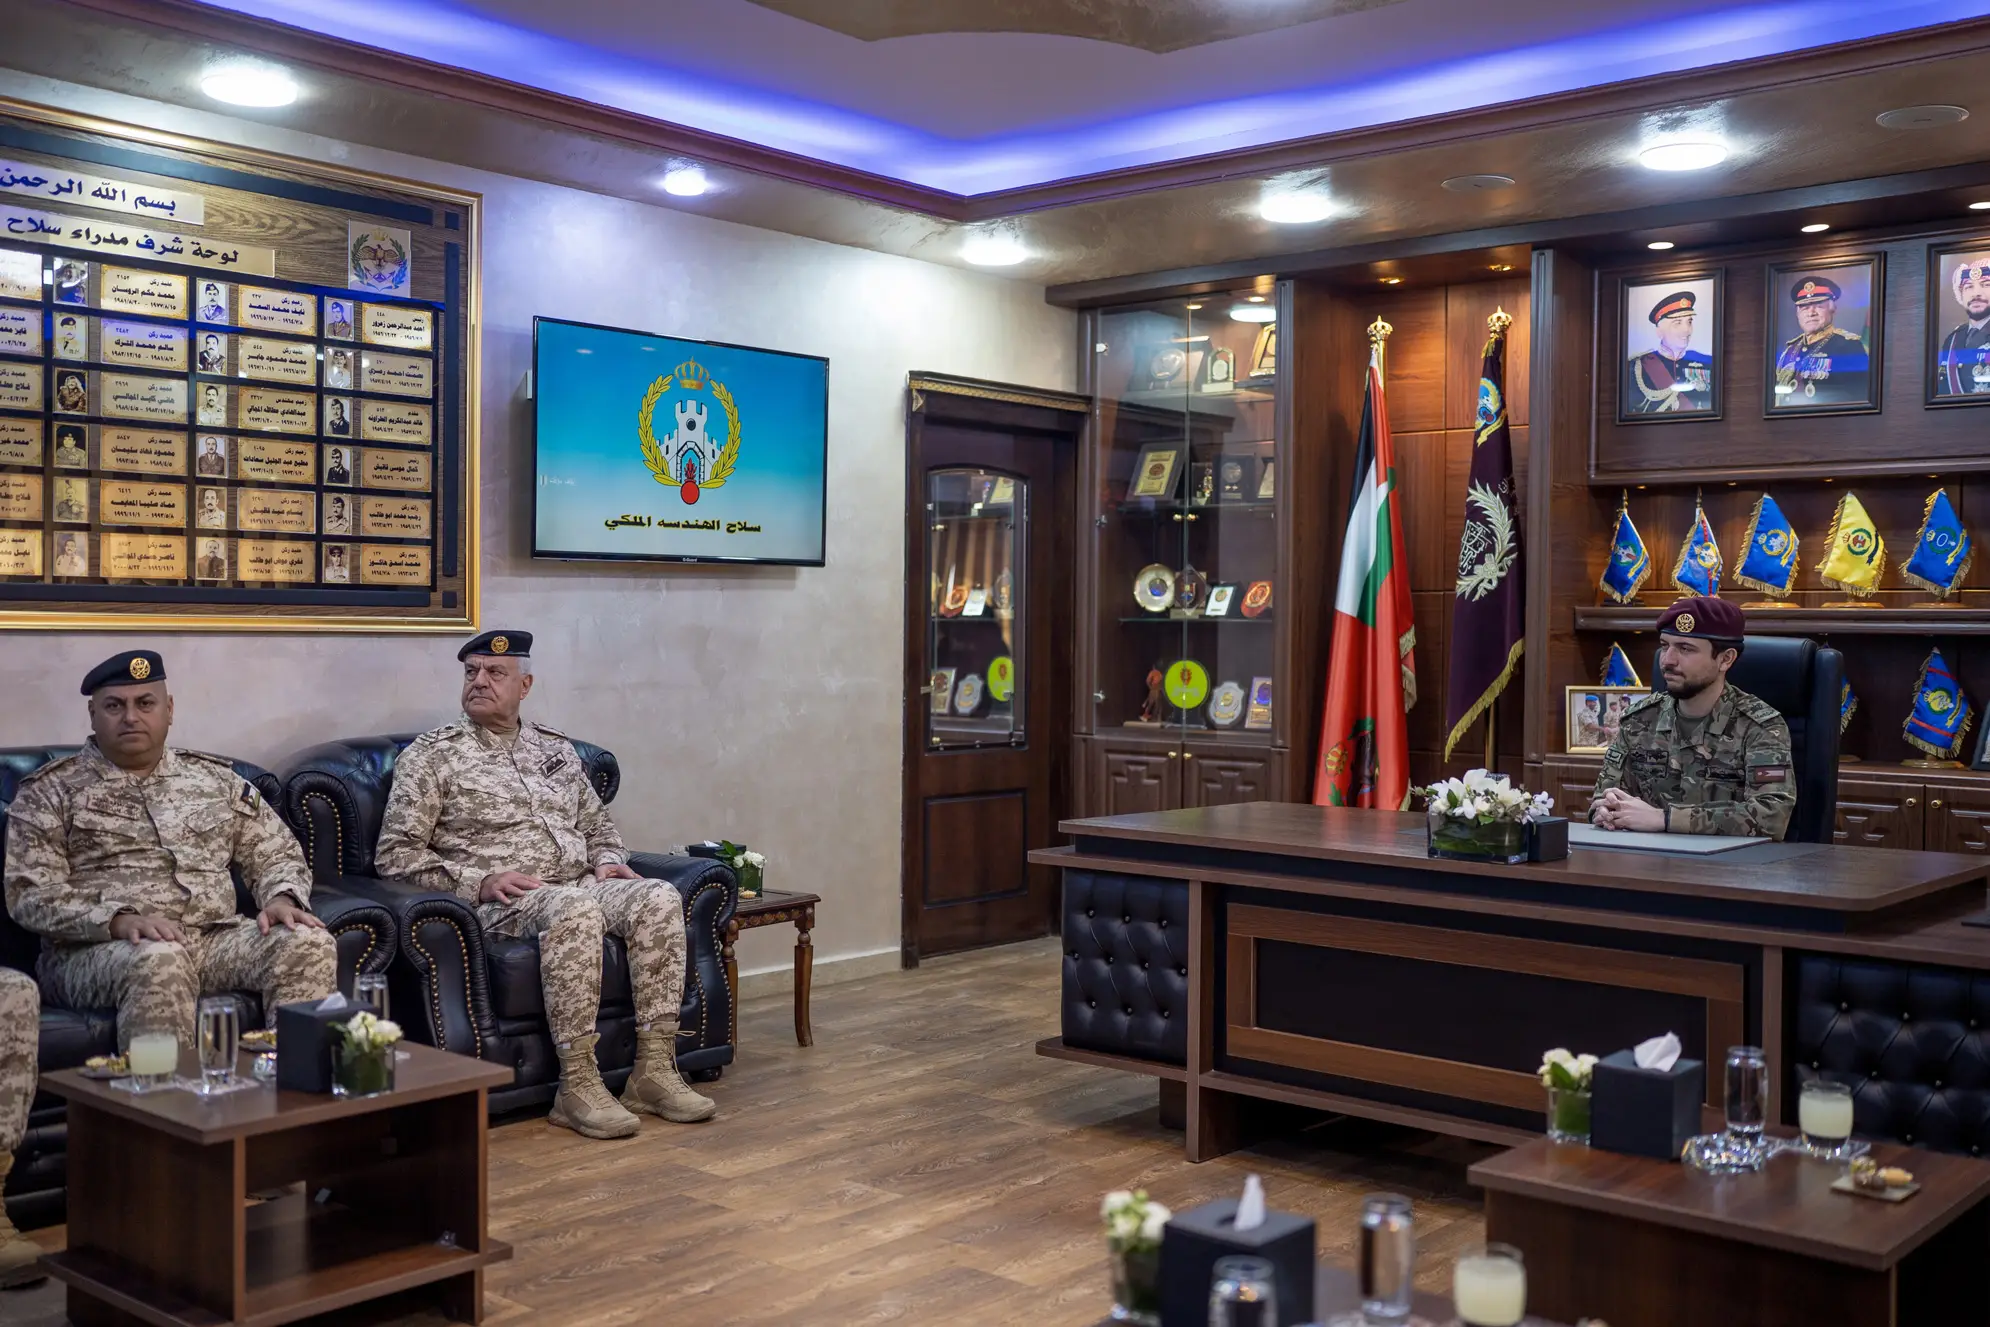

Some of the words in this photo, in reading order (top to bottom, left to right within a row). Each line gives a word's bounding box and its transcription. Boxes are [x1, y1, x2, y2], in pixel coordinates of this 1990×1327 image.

[0, 168, 82, 196] الرحمن
[91, 181, 126, 203] الله
[135, 195, 177, 217] بسم
[7, 216, 62, 235] سلاح
[70, 227, 129, 246] مدراء
[136, 234, 184, 256] شرف
[192, 240, 239, 265] لوحة
[604, 514, 652, 531] الملكي
[726, 520, 761, 533] سلاح
